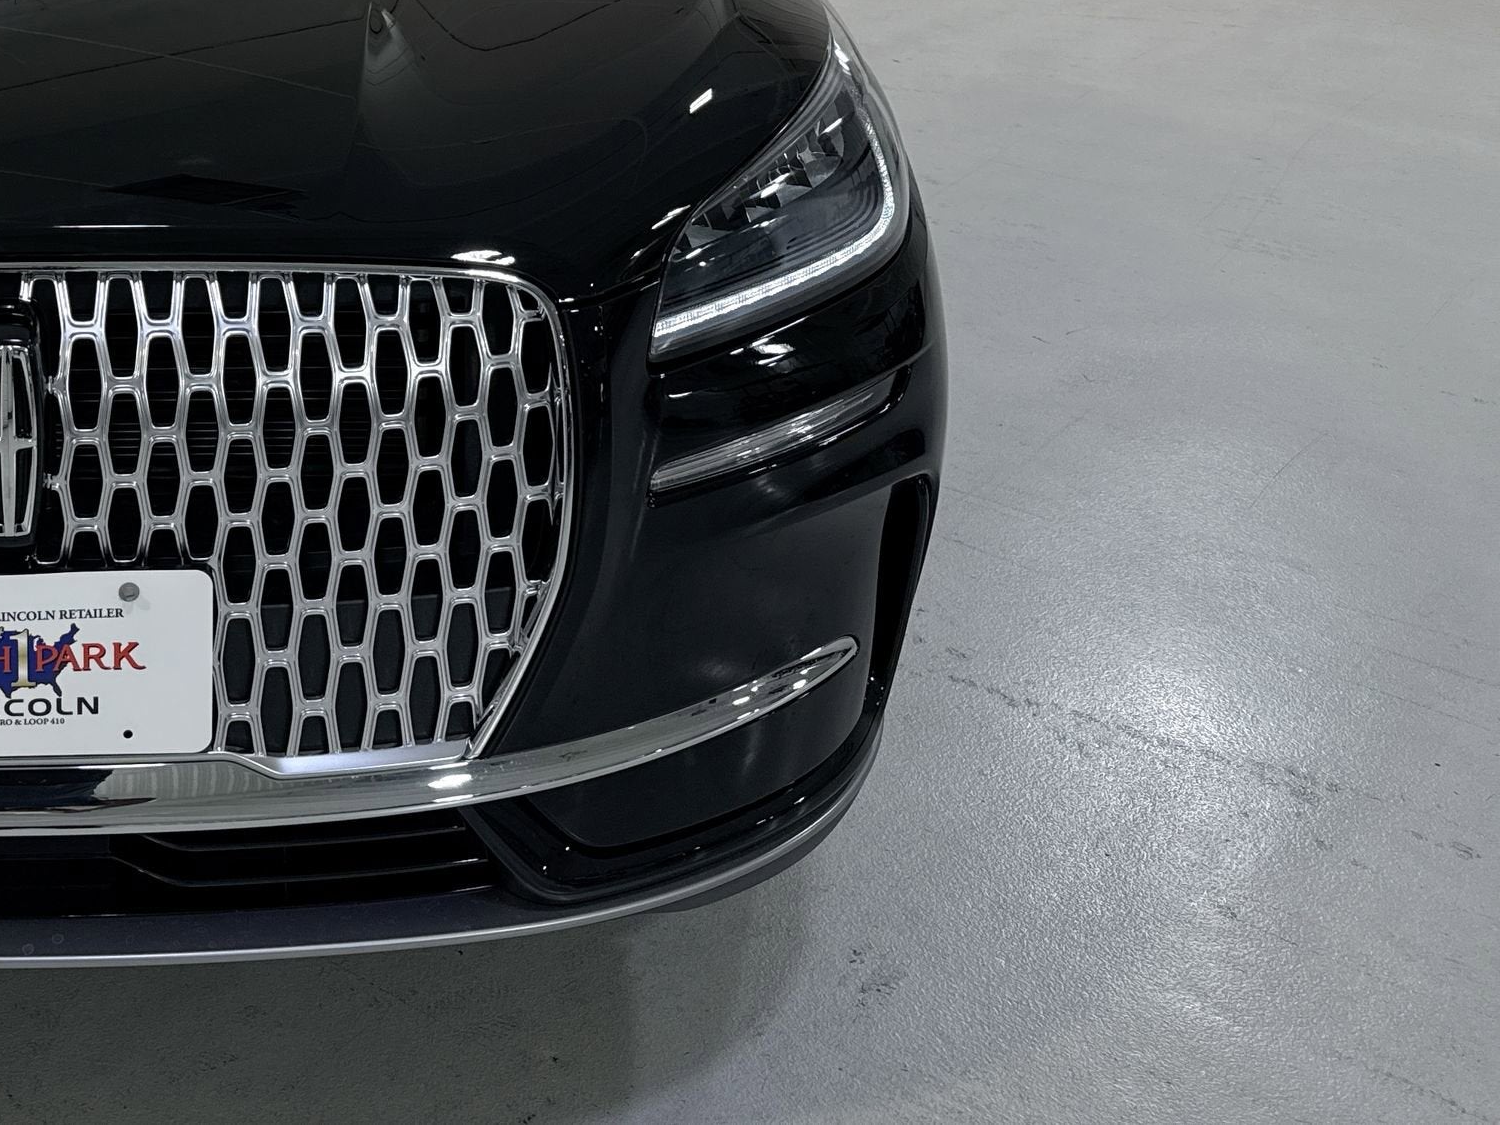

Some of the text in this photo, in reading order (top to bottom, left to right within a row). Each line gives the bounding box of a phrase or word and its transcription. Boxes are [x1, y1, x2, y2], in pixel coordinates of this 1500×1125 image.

[60, 608, 125, 621] RETAILER
[35, 641, 147, 673] PARK
[14, 718, 22, 726] &
[24, 717, 49, 726] LOOP
[50, 717, 66, 725] 410
